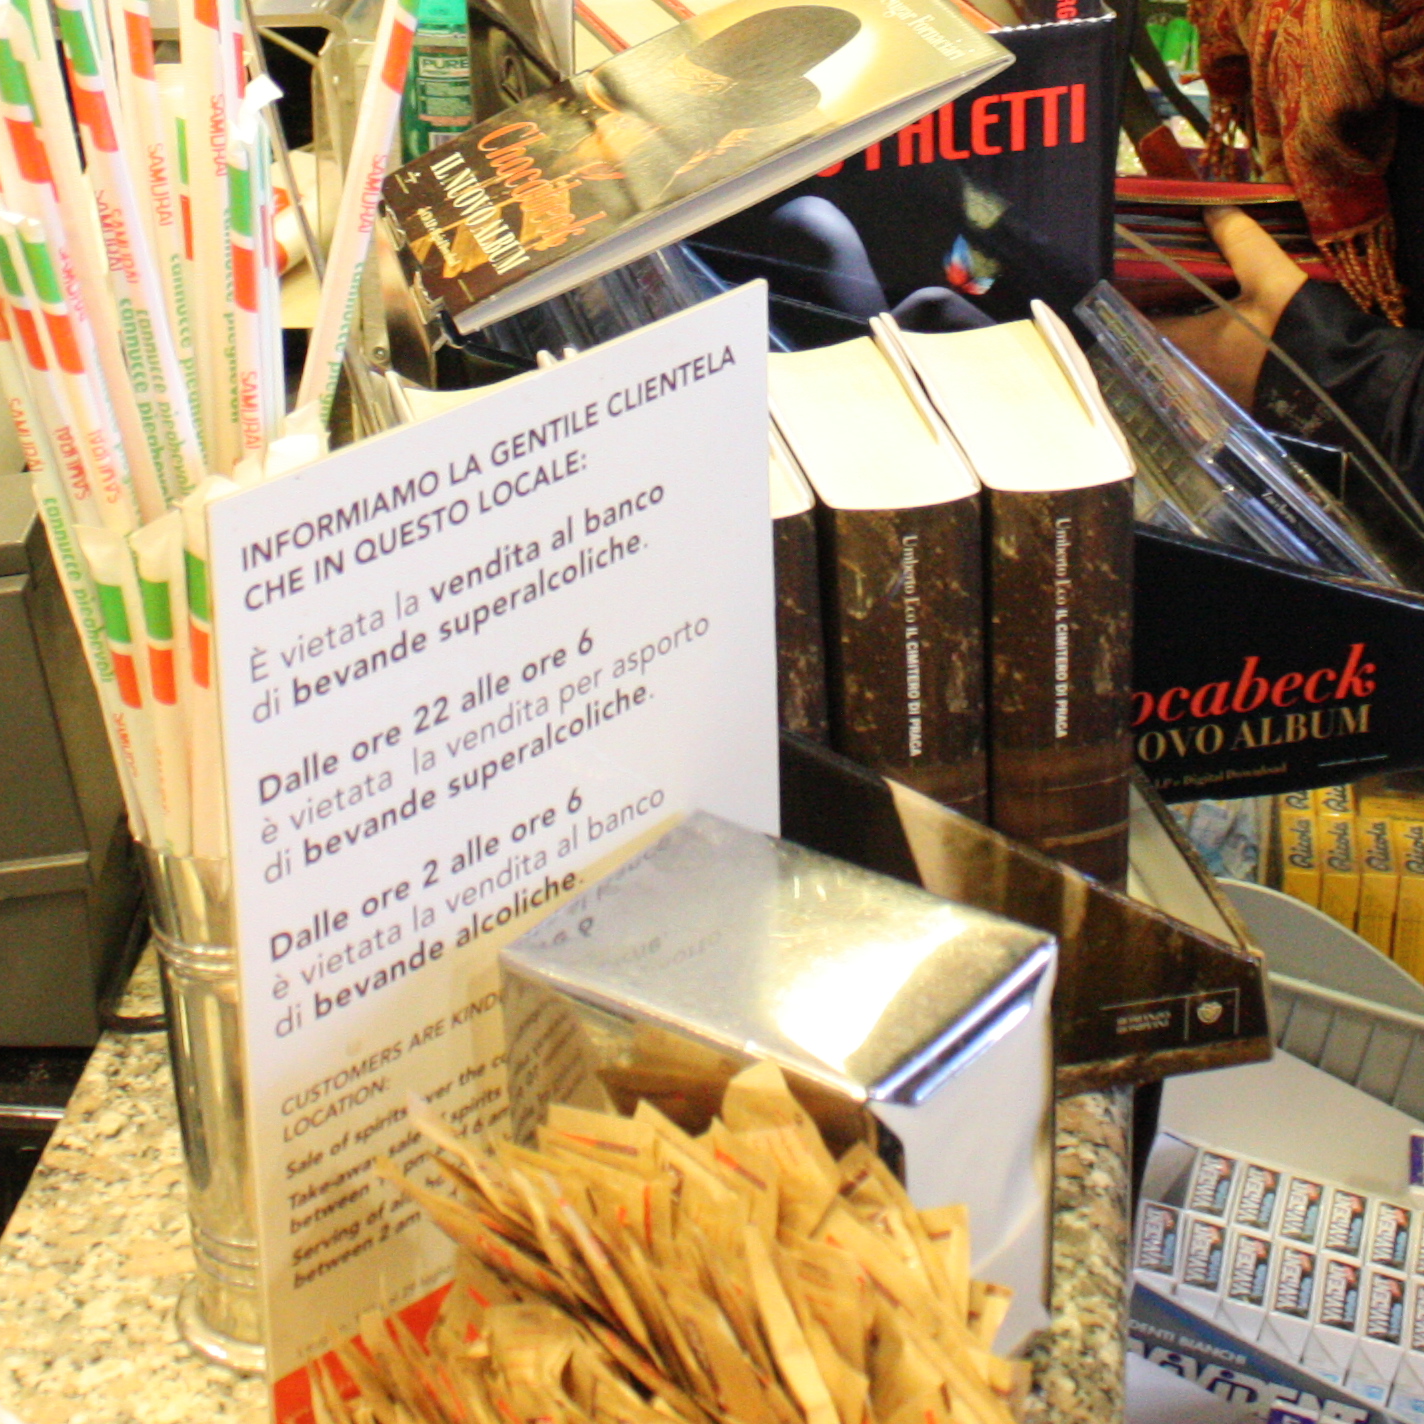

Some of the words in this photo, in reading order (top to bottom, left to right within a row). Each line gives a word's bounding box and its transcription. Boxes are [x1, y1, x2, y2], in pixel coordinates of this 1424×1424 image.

[421, 57, 470, 71] PURE
[147, 143, 174, 227] SAMURAI
[357, 153, 388, 234] SAMURAI
[443, 167, 498, 227] NUOVO
[469, 218, 531, 276] ALBUM
[119, 297, 149, 394] cannucce
[240, 370, 262, 450] SAMURAI
[87, 428, 121, 505] SAMURAI
[240, 468, 440, 572] INFORMIAMO
[449, 452, 484, 487] LA
[490, 402, 600, 469] GENTILE
[606, 344, 737, 419] CLIENTELA
[243, 567, 305, 613] CHE
[314, 548, 345, 584] IN
[355, 498, 469, 567] QUESTO
[478, 450, 588, 514] LOCALE:
[902, 533, 919, 595] Umberto
[1054, 516, 1072, 577] Umberto
[248, 644, 269, 683] È
[280, 597, 385, 670] vietata
[396, 589, 420, 622] la
[429, 536, 542, 604] vendita
[551, 516, 575, 552] al
[583, 482, 666, 535] banco
[904, 595, 920, 624] Eco
[1054, 578, 1072, 606] Eco
[1054, 608, 1069, 622] IL
[251, 688, 282, 726] di
[291, 626, 427, 707] bevande
[437, 529, 650, 643] superalcoliche.
[905, 626, 919, 640] IL
[1054, 623, 1069, 682] CIMITERO
[905, 641, 921, 700] CIMITERO
[1054, 683, 1068, 697] DI
[1130, 642, 1378, 726] ocabeck
[258, 752, 339, 806] Dalle
[350, 726, 402, 762] ore
[412, 697, 452, 734] 22
[459, 672, 512, 714] alle
[519, 646, 569, 683] ore
[577, 628, 595, 655] 6
[260, 815, 280, 845] è
[288, 768, 395, 831] vietata
[412, 746, 437, 776] la
[445, 693, 551, 760] vendita
[557, 664, 603, 711] per
[611, 613, 710, 685] asporto
[907, 701, 921, 716] DI
[908, 716, 923, 758] PRAGA
[1054, 698, 1069, 739] PRAGA
[1137, 724, 1225, 763] OVO
[1229, 704, 1373, 751] ALBUM
[263, 854, 293, 886] di
[302, 788, 437, 868] bevande
[446, 682, 655, 800] superalcoliche.
[269, 906, 350, 963] Dalle
[360, 881, 411, 918] ore
[421, 859, 440, 889] 2
[450, 834, 500, 876] alle
[510, 807, 557, 844] ore
[565, 786, 584, 816] 6
[1287, 818, 1314, 869] Ricola
[1327, 821, 1354, 873] Ricola
[1365, 821, 1393, 873] Ricola
[271, 972, 290, 1002] è
[300, 922, 404, 986] vietata
[413, 903, 436, 932] la
[445, 850, 550, 914] vendita
[556, 824, 578, 859] al
[586, 787, 666, 843] banco
[274, 1004, 304, 1038] di
[313, 938, 445, 1020] bevande
[454, 871, 585, 949] alcoliche.
[279, 1039, 403, 1117] CUSTOMERS
[407, 1017, 446, 1052] ARE
[450, 990, 501, 1029] KIND
[282, 1075, 392, 1143] LOCATION:
[285, 1149, 325, 1180] Sale
[329, 1134, 350, 1158] of
[354, 1103, 409, 1147] spirits
[422, 1075, 454, 1105] ver
[457, 1060, 487, 1087] the
[388, 1129, 422, 1158] sale
[450, 1085, 502, 1128] spirits
[289, 1181, 370, 1236] between
[291, 1219, 362, 1267] Serving
[366, 1198, 386, 1222] of
[292, 1235, 374, 1291] between
[378, 1221, 391, 1243] 2
[393, 1209, 422, 1234] am
[1128, 1319, 1175, 1343] DENTI
[1179, 1335, 1248, 1366] BIANCHI
